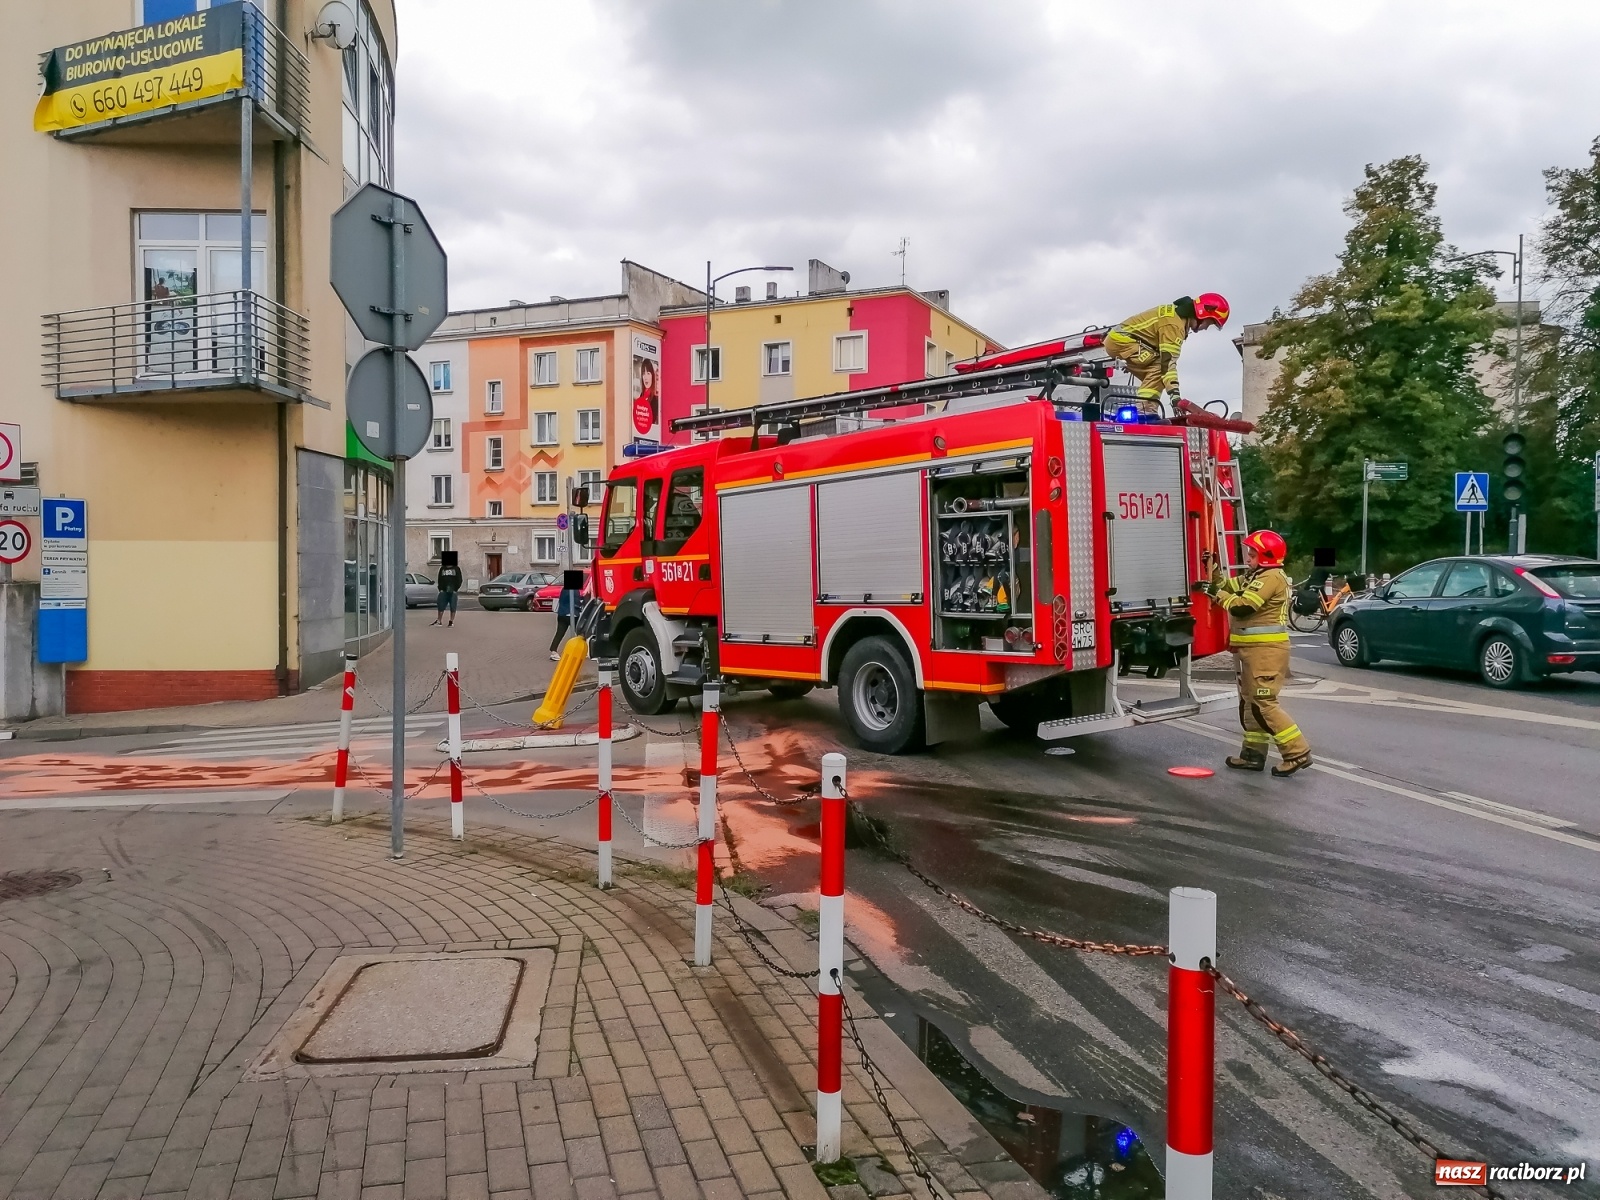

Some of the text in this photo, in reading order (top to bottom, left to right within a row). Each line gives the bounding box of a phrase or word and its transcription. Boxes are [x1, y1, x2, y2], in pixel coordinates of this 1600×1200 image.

[65, 12, 207, 62] DO WYNAJĘCIA LOKALE
[66, 34, 204, 82] BIUROWO-USŁUGOWE
[93, 67, 204, 113] 660 497 449
[13, 503, 38, 512] ruchu
[55, 506, 75, 532] P
[0, 530, 25, 551] 20
[1073, 622, 1091, 635] SRC
